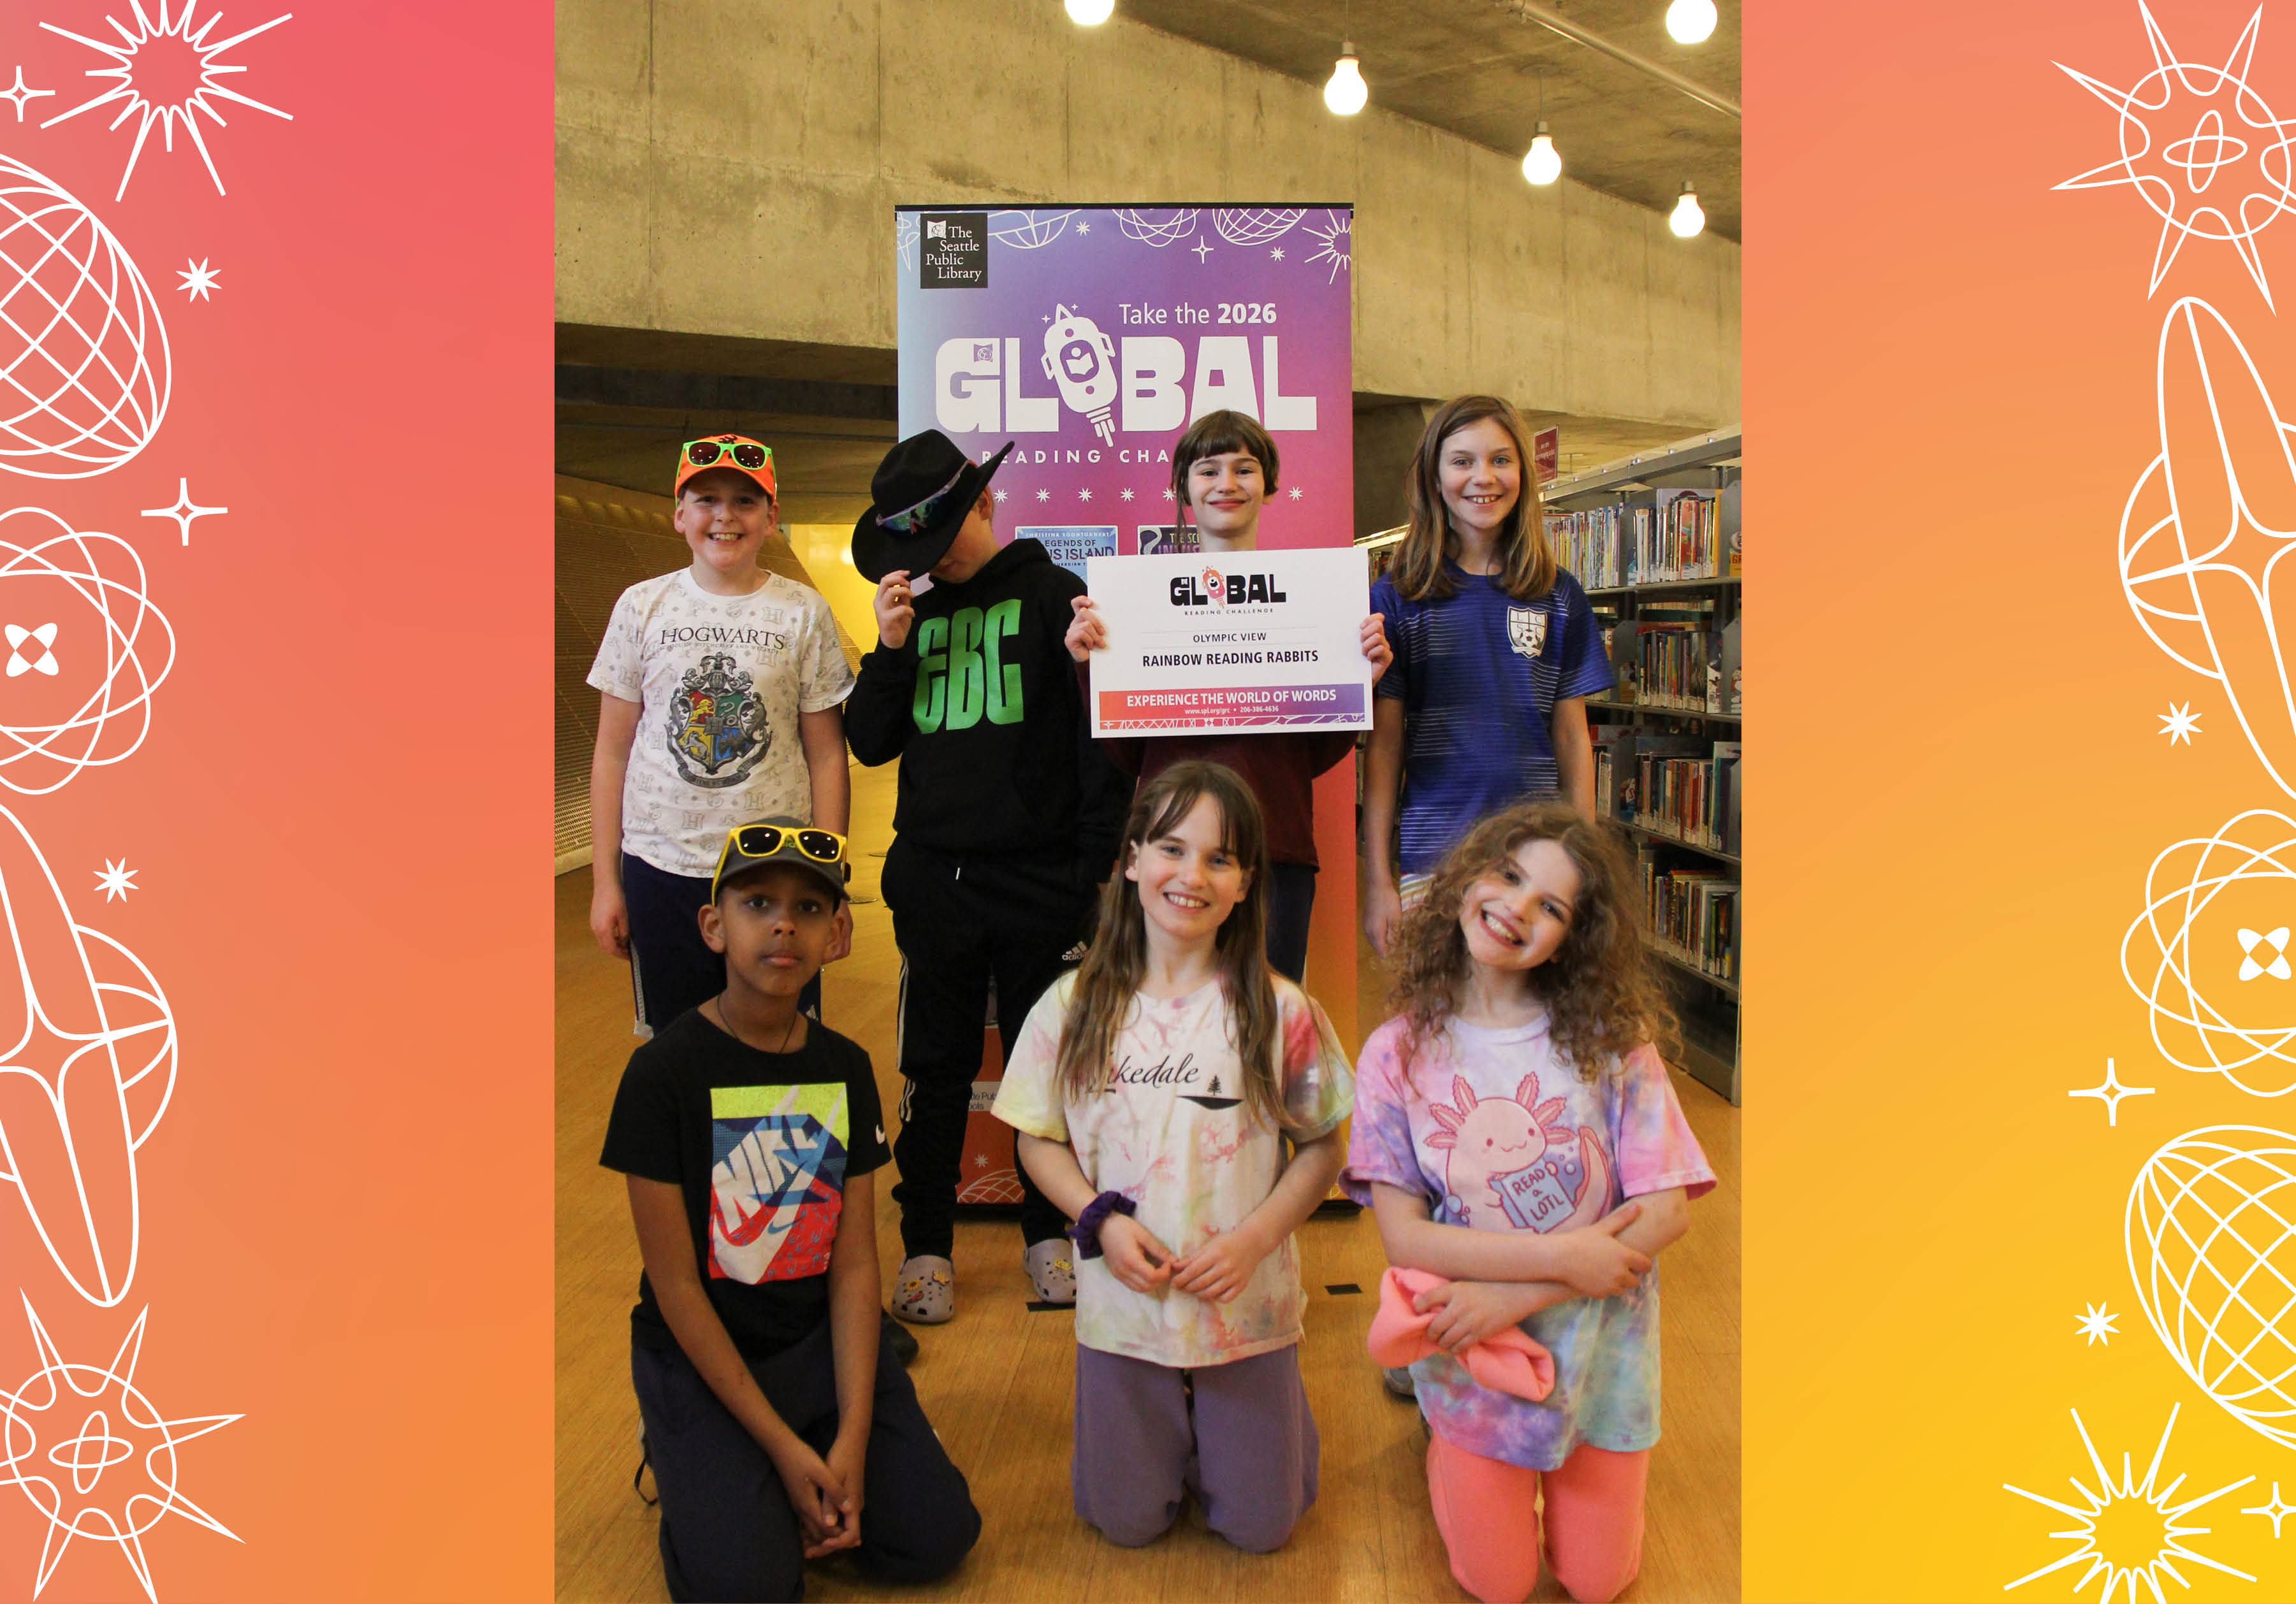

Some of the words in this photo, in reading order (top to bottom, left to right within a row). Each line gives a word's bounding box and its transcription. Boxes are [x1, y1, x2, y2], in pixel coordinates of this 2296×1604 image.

[948, 226, 972, 238] The
[940, 239, 980, 252] Seattle
[926, 253, 964, 265] Public
[938, 266, 982, 282] Library
[1119, 302, 1167, 324] Take
[1175, 302, 1209, 324] the
[1217, 303, 1277, 324] 2026
[935, 335, 1317, 435] GLOBAL
[982, 449, 1101, 464] RADING
[1066, 546, 1114, 560] ISLAND
[1170, 573, 1286, 607] GLOBAL
[660, 627, 785, 650] HOGWARTS
[1193, 633, 1237, 643] OLYMPIC
[1240, 633, 1267, 641] VIEW
[1143, 654, 1202, 667] RAINBOW
[1207, 652, 1262, 665] READING
[1267, 650, 1318, 663] RABBITS
[1127, 693, 1198, 707] EXPERIENCE
[1200, 693, 1224, 704] THE
[1226, 691, 1272, 704] WORLD
[1274, 691, 1290, 702] OF
[1292, 690, 1336, 702] WORDS
[1106, 1052, 1200, 1089] kedale
[1512, 1169, 1545, 1196] READ
[1530, 1195, 1564, 1222] LOTL
